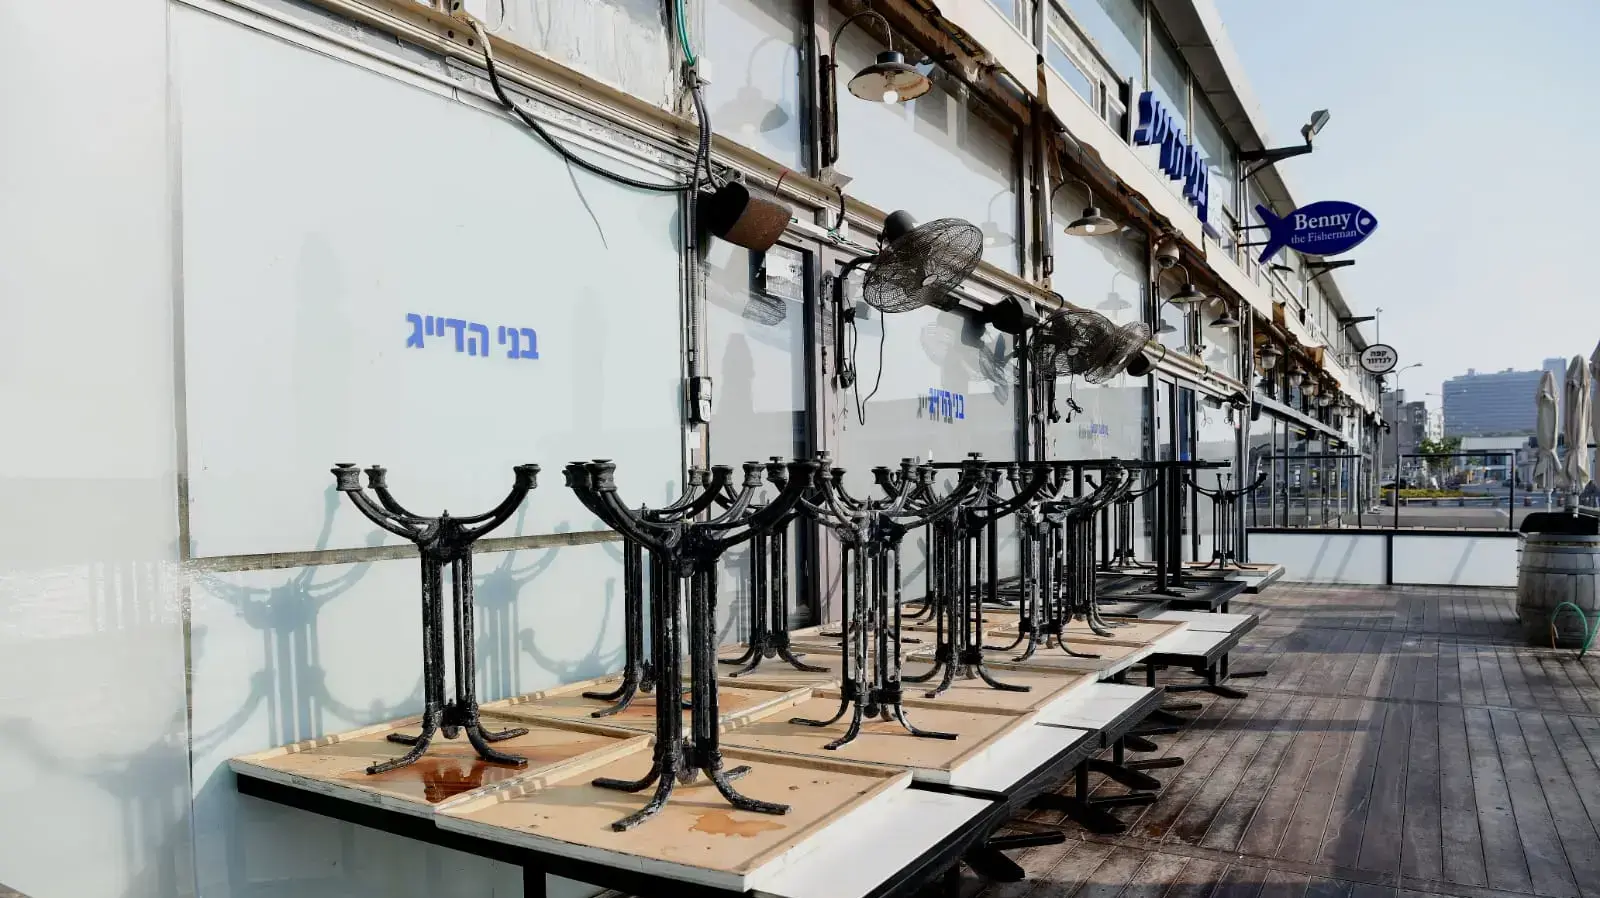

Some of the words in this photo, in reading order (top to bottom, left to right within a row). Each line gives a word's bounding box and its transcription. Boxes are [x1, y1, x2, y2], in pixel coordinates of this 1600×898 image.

[1294, 213, 1352, 231] Benny
[1291, 234, 1305, 244] the
[1307, 230, 1357, 243] Fisherman
[405, 312, 489, 357] הדייג
[497, 325, 539, 360] בני
